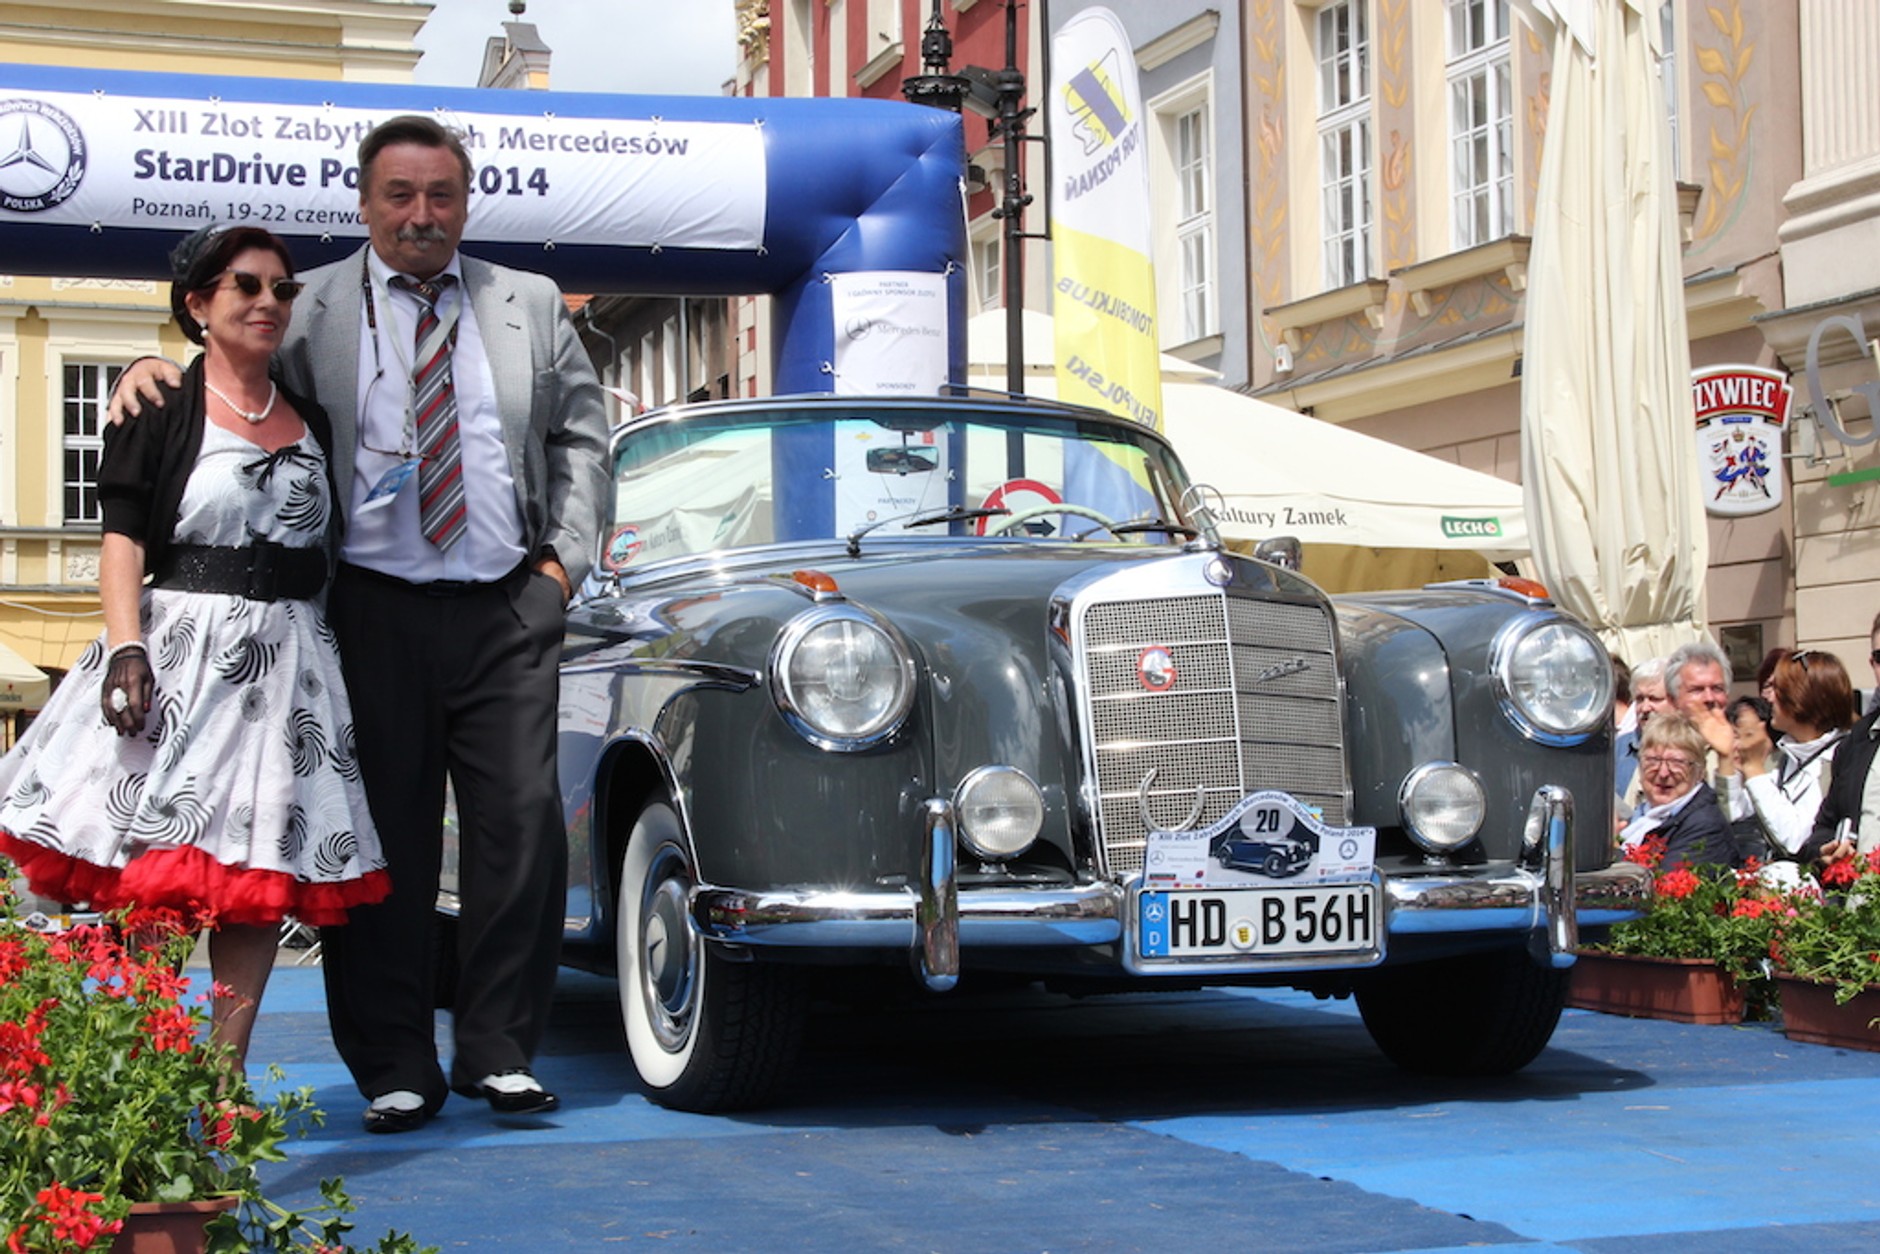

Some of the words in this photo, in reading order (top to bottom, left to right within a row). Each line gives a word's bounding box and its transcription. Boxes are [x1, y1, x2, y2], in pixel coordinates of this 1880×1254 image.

[133, 108, 188, 135] XIII
[200, 112, 263, 139] Zlot
[499, 126, 689, 156] Mercedesów
[133, 148, 307, 187] StarDrive
[3, 197, 46, 211] POLSKA
[132, 197, 217, 222] Poznań,
[226, 202, 287, 223] 19-22
[1283, 507, 1347, 527] Zamek
[1256, 809, 1280, 833] 20
[1171, 899, 1226, 948] HD
[1149, 931, 1161, 946] D
